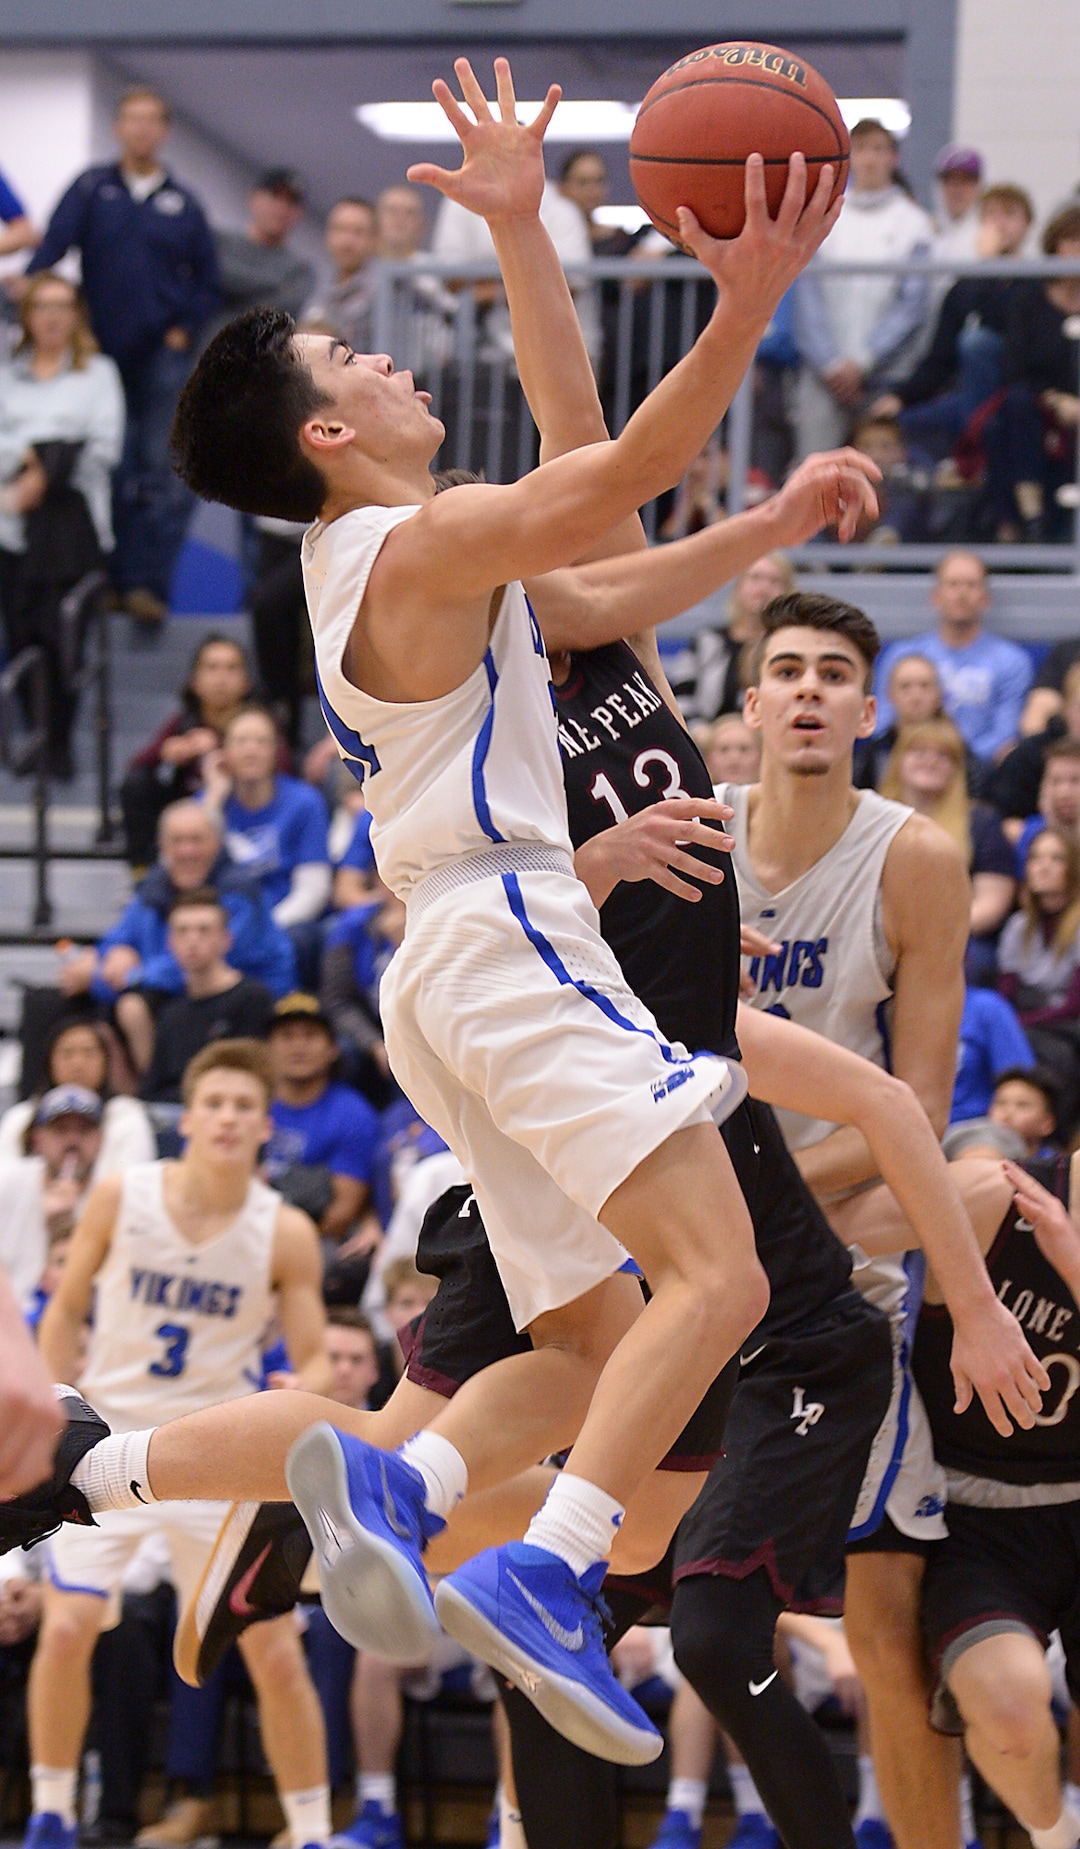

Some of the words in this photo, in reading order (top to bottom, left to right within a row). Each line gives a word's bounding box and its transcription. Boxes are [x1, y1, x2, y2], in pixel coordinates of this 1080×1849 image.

[558, 718, 602, 759] NE
[590, 670, 663, 741] PEAK
[591, 748, 700, 846] 13
[750, 937, 828, 992] INGS
[130, 1266, 242, 1319] VIKINGS
[149, 1324, 190, 1378] 3
